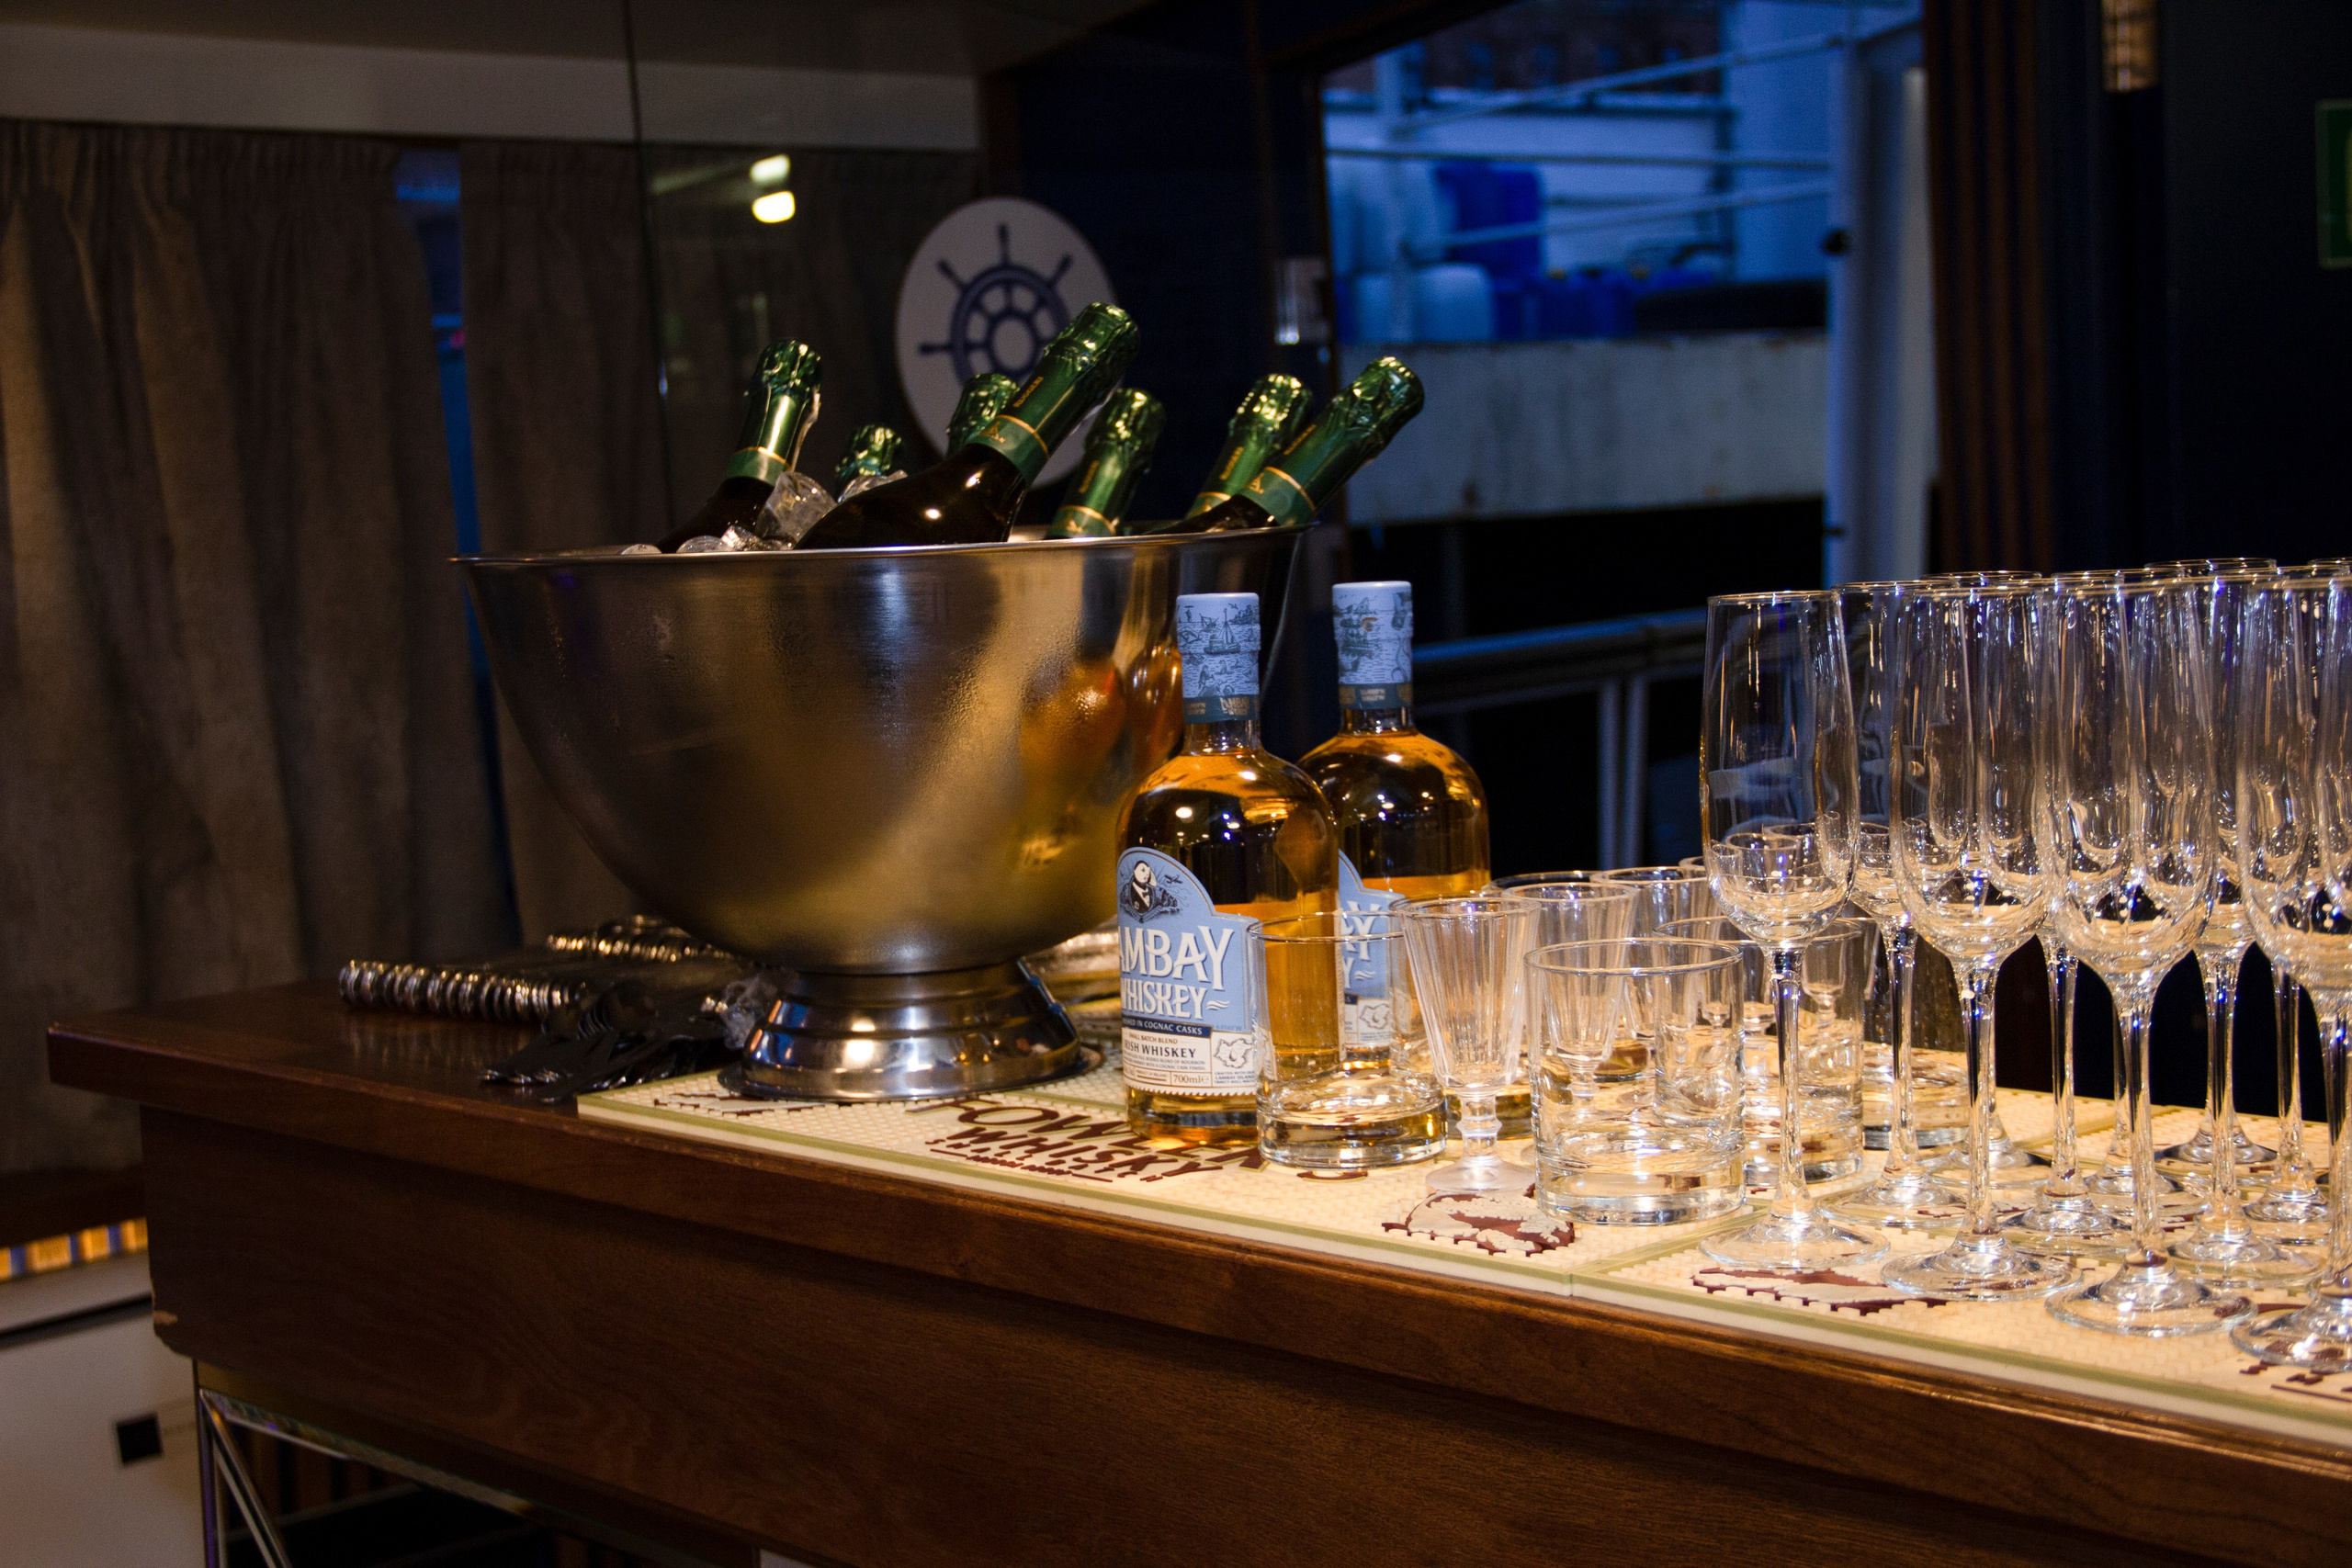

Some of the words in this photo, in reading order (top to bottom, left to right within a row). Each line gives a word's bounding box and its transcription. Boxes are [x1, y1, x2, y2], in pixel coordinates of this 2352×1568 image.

[1144, 1021, 1174, 1032] COGNAC
[1176, 1025, 1203, 1035] CASKS
[1141, 1034, 1157, 1043] BATCH
[1142, 1043, 1196, 1058] WHISKEY
[945, 1126, 1224, 1177] WHISKY
